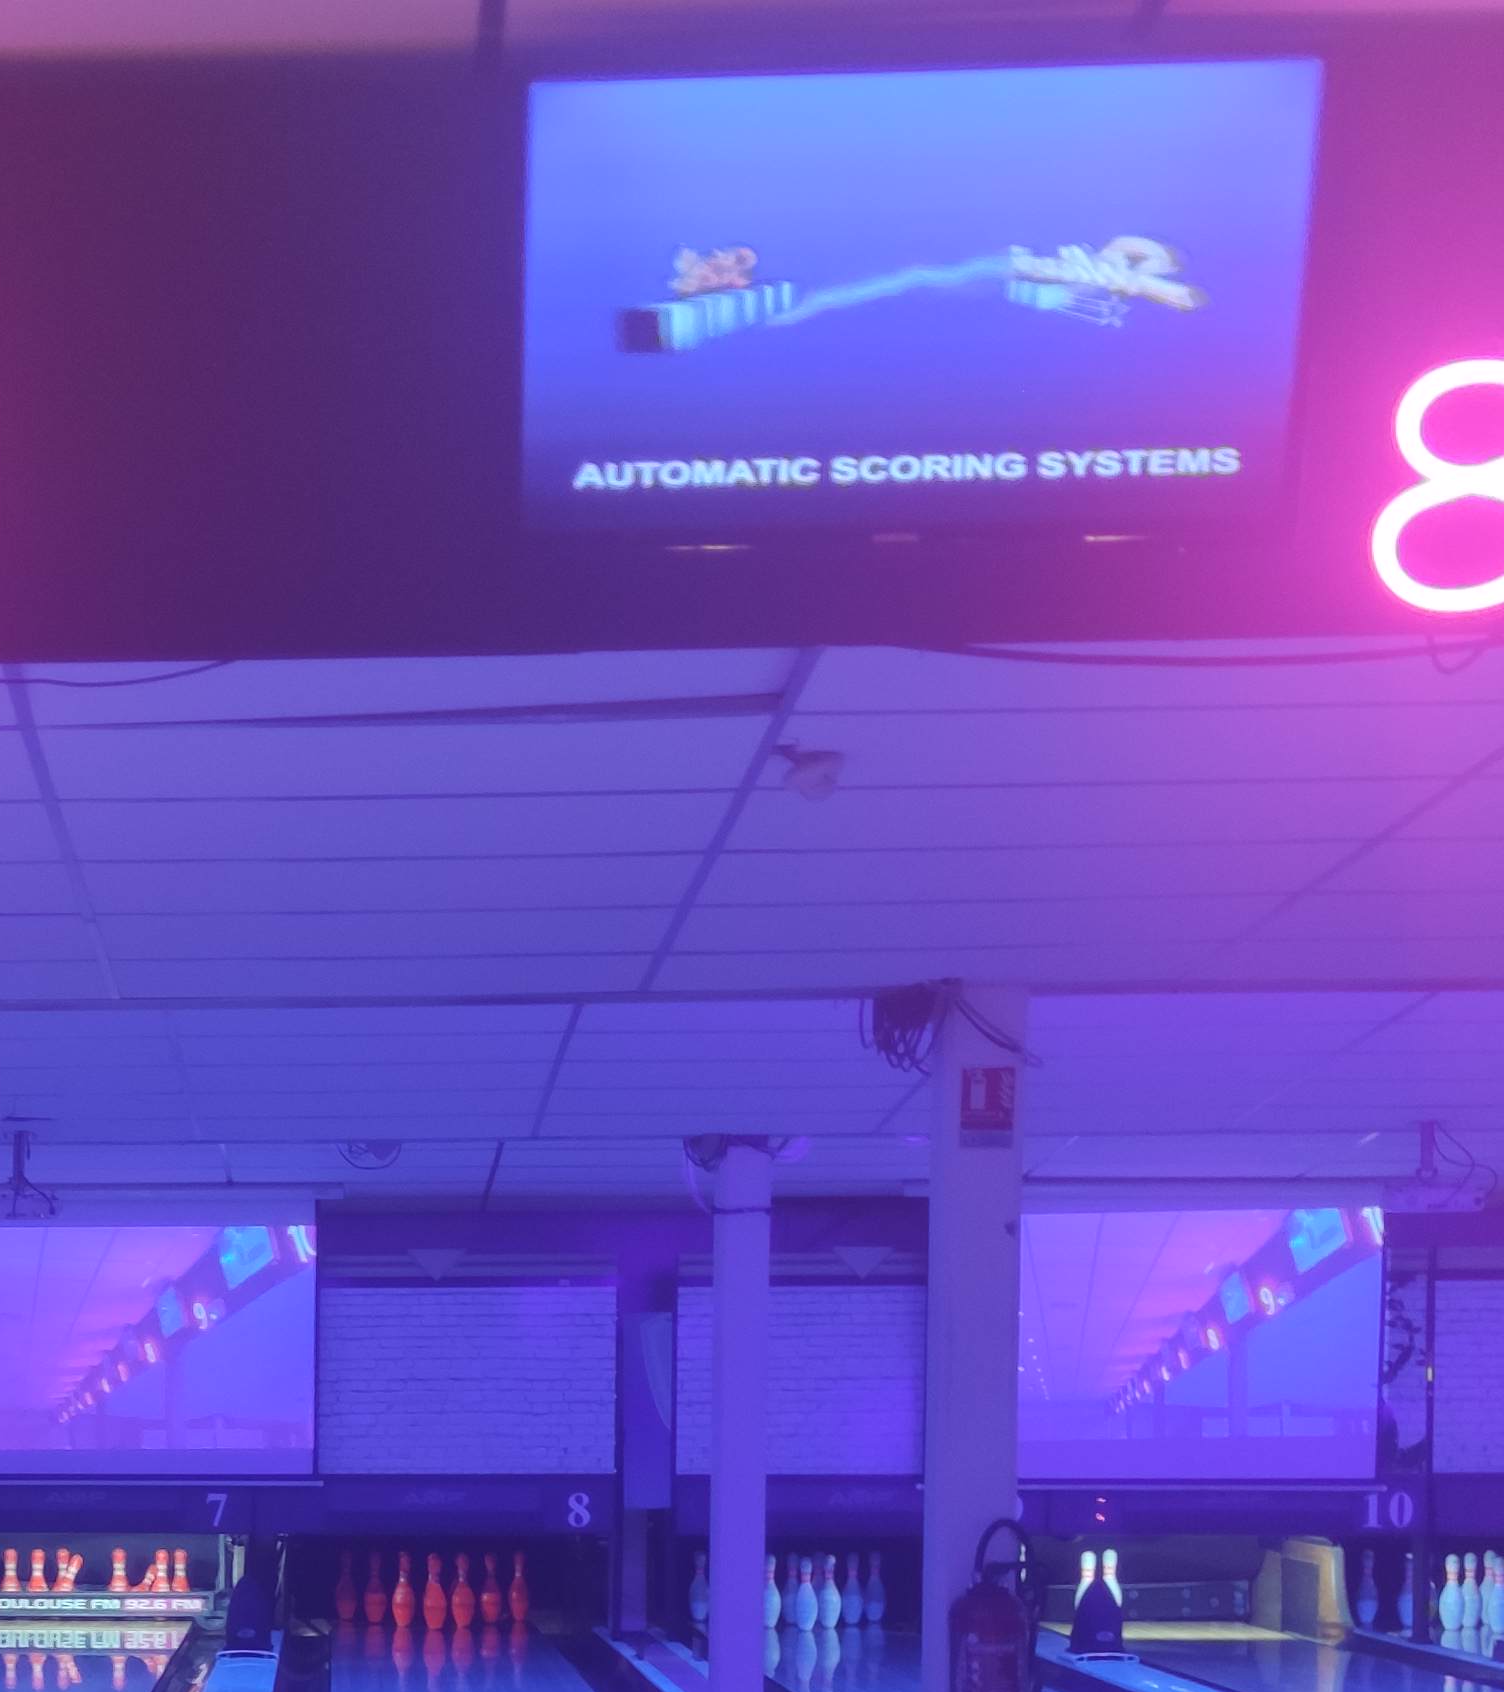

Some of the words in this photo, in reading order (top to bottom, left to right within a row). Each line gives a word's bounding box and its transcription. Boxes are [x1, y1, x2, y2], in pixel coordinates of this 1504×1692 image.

[573, 459, 821, 490] AUTOMATIC
[830, 453, 1027, 484] SCORING
[1036, 447, 1242, 479] SYSTEMS
[205, 1492, 229, 1528] 7
[567, 1492, 591, 1528] 8
[1361, 1491, 1414, 1529] 10
[90, 1598, 122, 1611] FM
[124, 1597, 168, 1611] 92.6
[172, 1597, 204, 1611] FM
